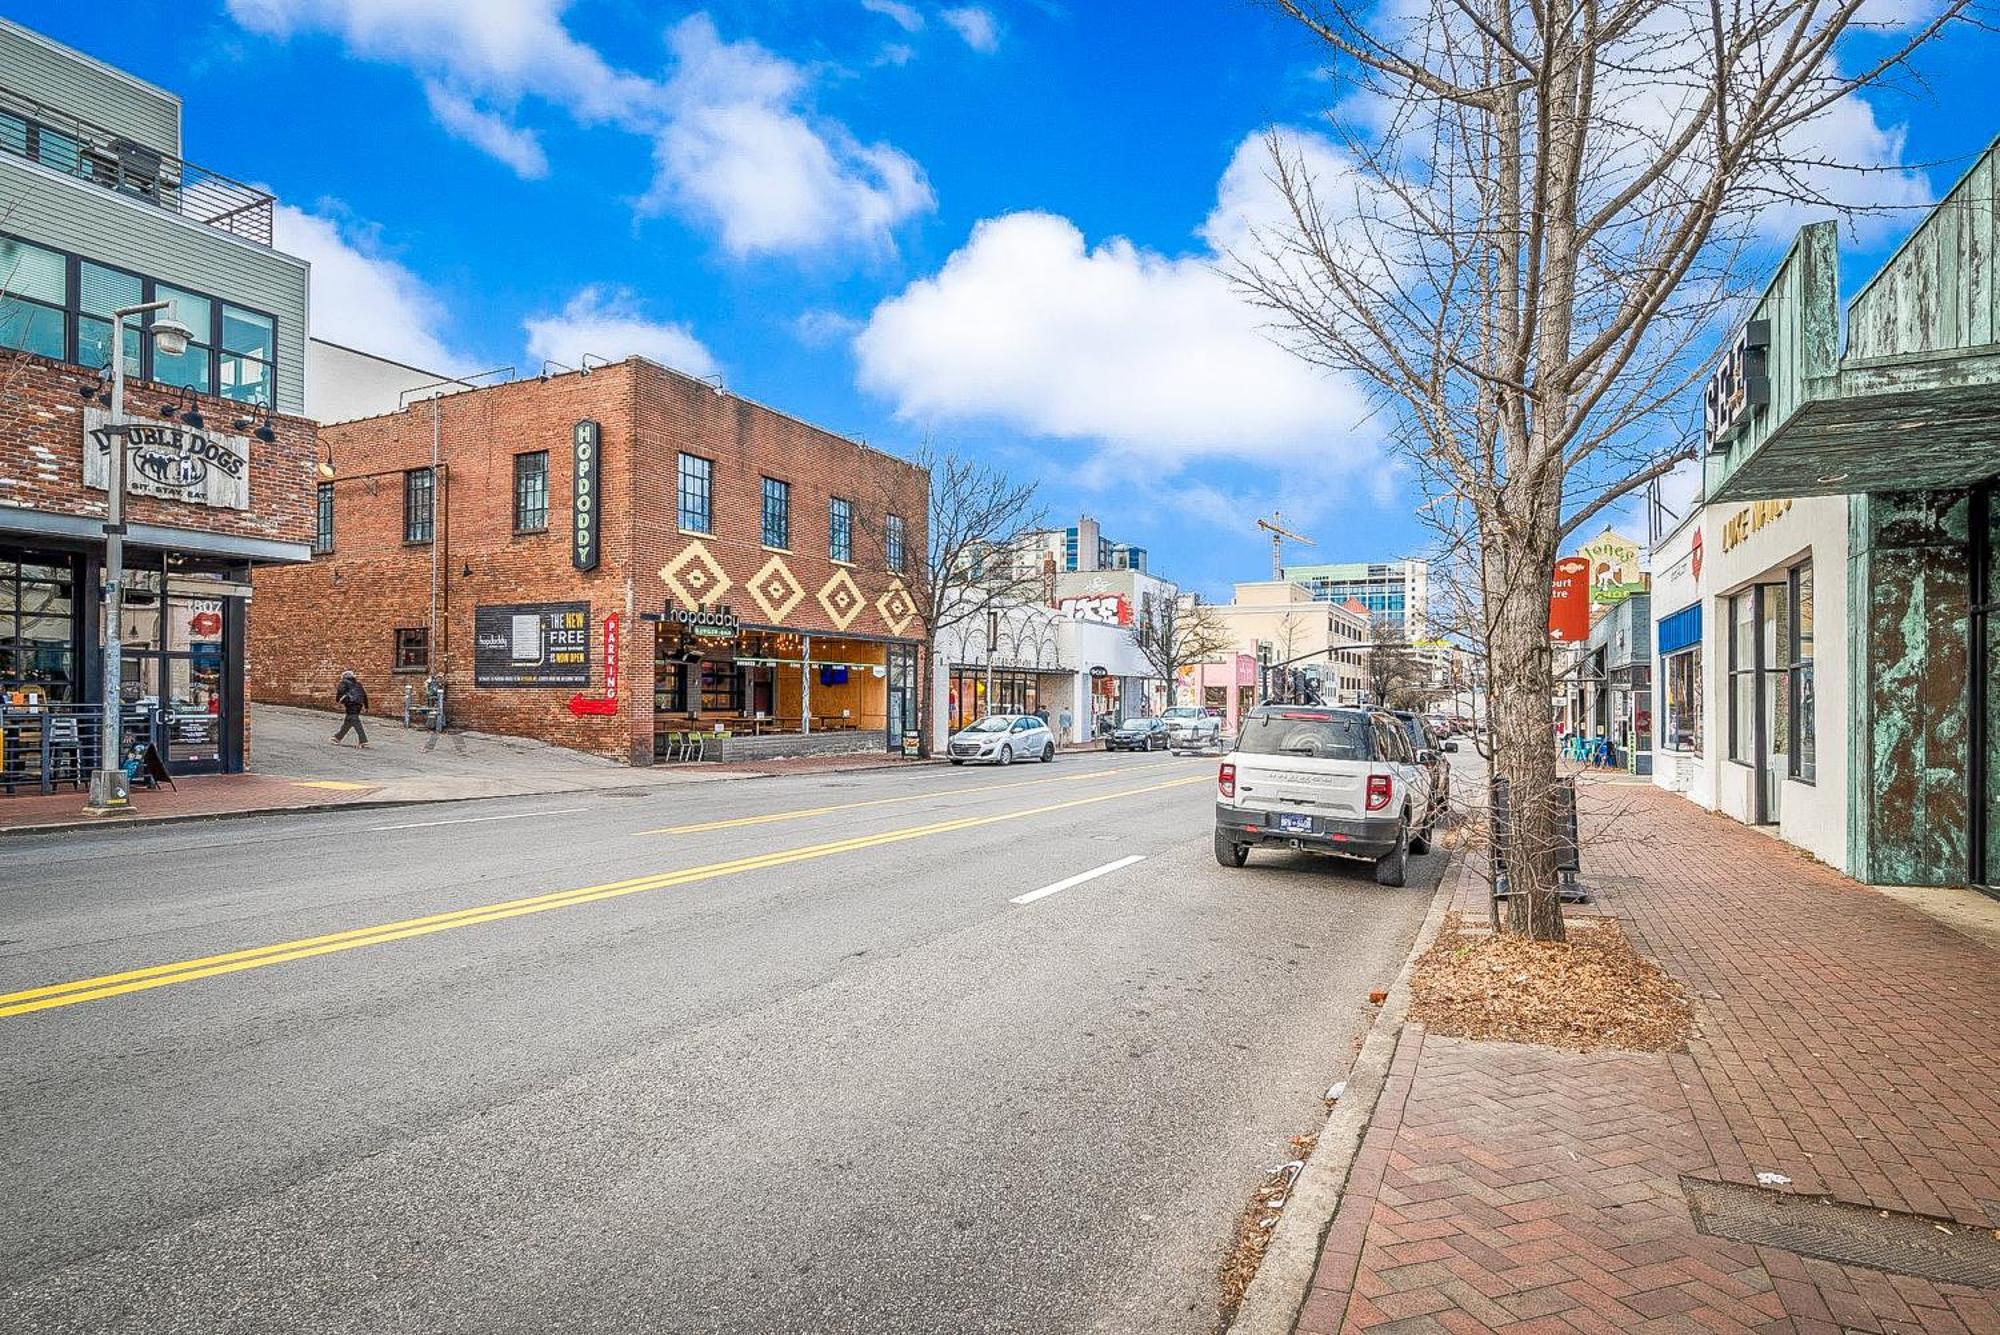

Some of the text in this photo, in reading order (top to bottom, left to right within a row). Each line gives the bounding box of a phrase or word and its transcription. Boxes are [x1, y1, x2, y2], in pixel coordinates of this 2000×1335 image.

[90, 425, 245, 475] DUBLE DOGS
[577, 426, 591, 563] HOPDODDY
[1584, 543, 1634, 564] Jones
[1551, 578, 1571, 587] ourt
[1551, 589, 1568, 598] tre
[550, 612, 584, 629] THE NEW
[550, 630, 585, 644] FREE
[607, 622, 615, 699] PARKING
